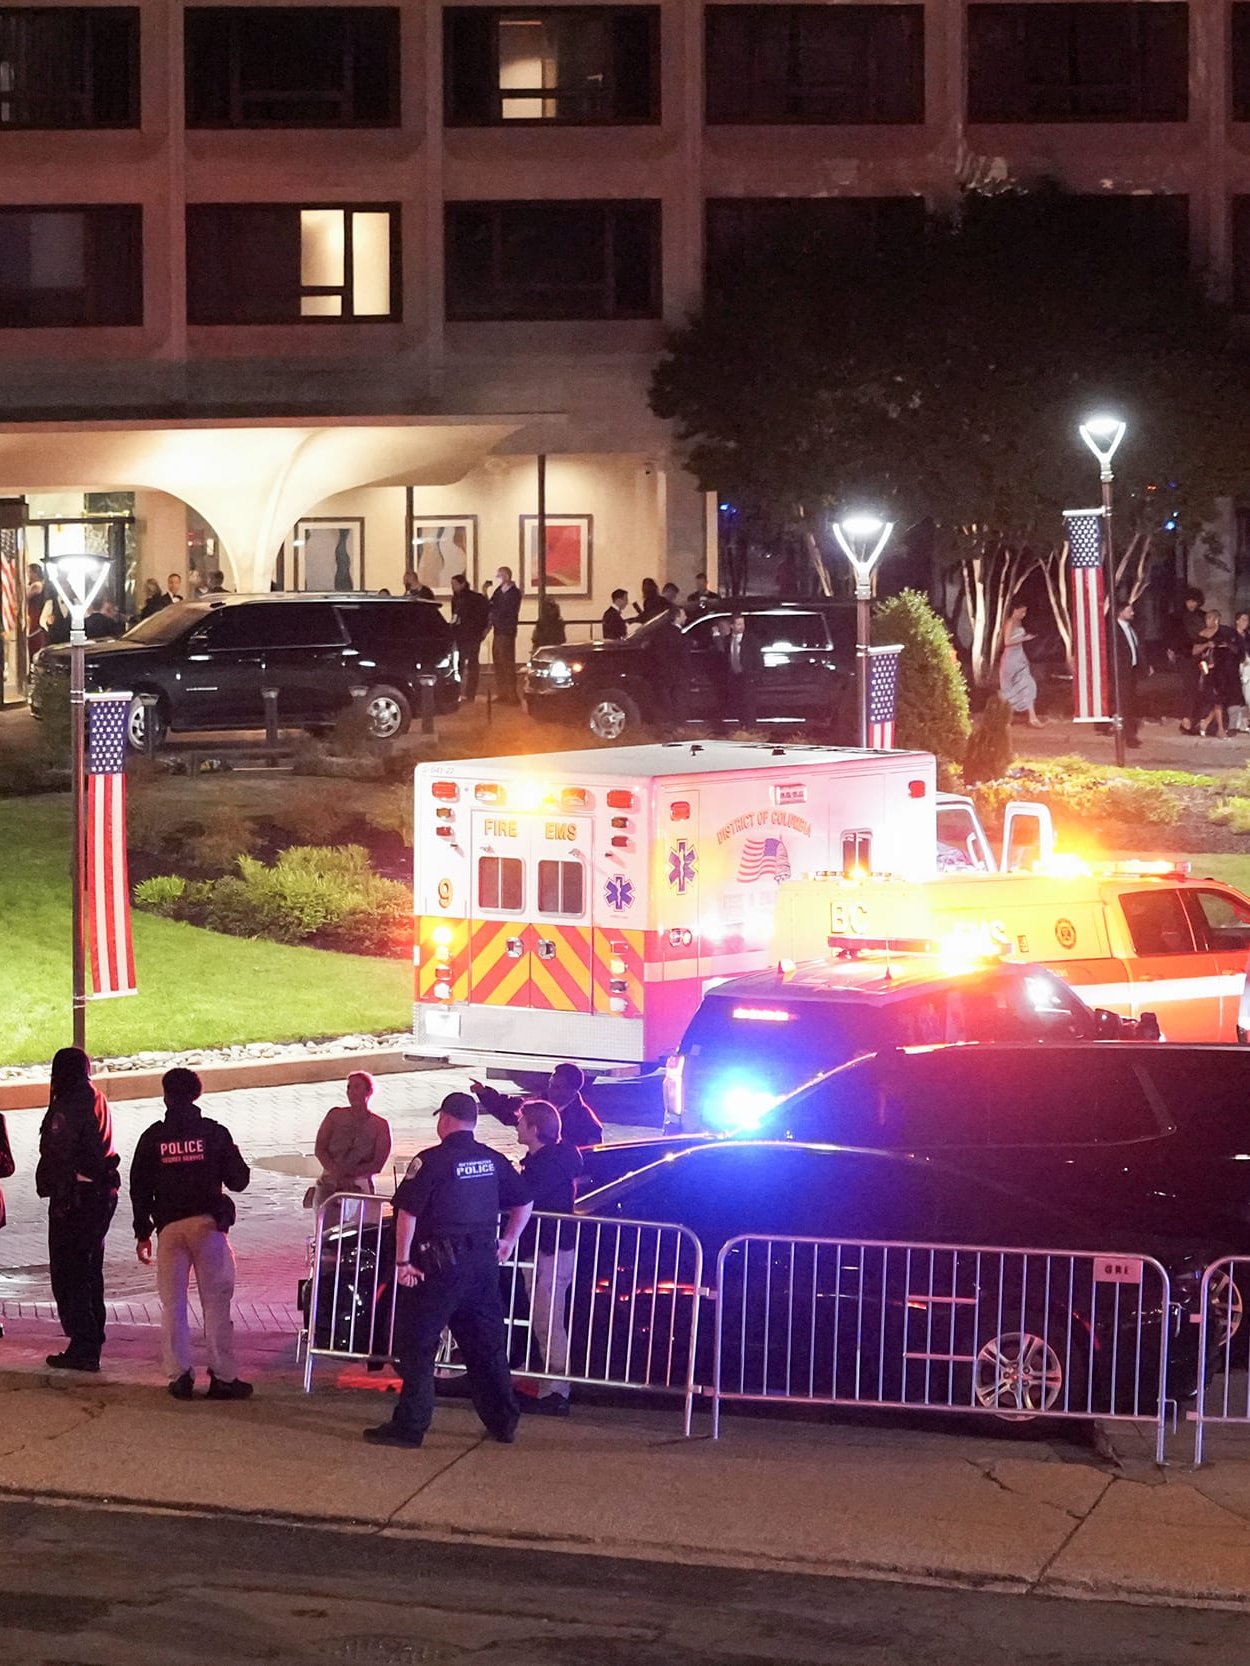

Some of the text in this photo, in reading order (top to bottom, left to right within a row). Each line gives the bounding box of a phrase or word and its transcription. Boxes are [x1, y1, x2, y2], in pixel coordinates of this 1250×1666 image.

[484, 818, 577, 841] FIRE EMS
[716, 809, 812, 845] DISTRICT OF COLUMBIA
[438, 878, 454, 909] 9
[830, 900, 869, 935] BC
[160, 1140, 204, 1156] POLICE
[456, 1163, 495, 1176] POLICE
